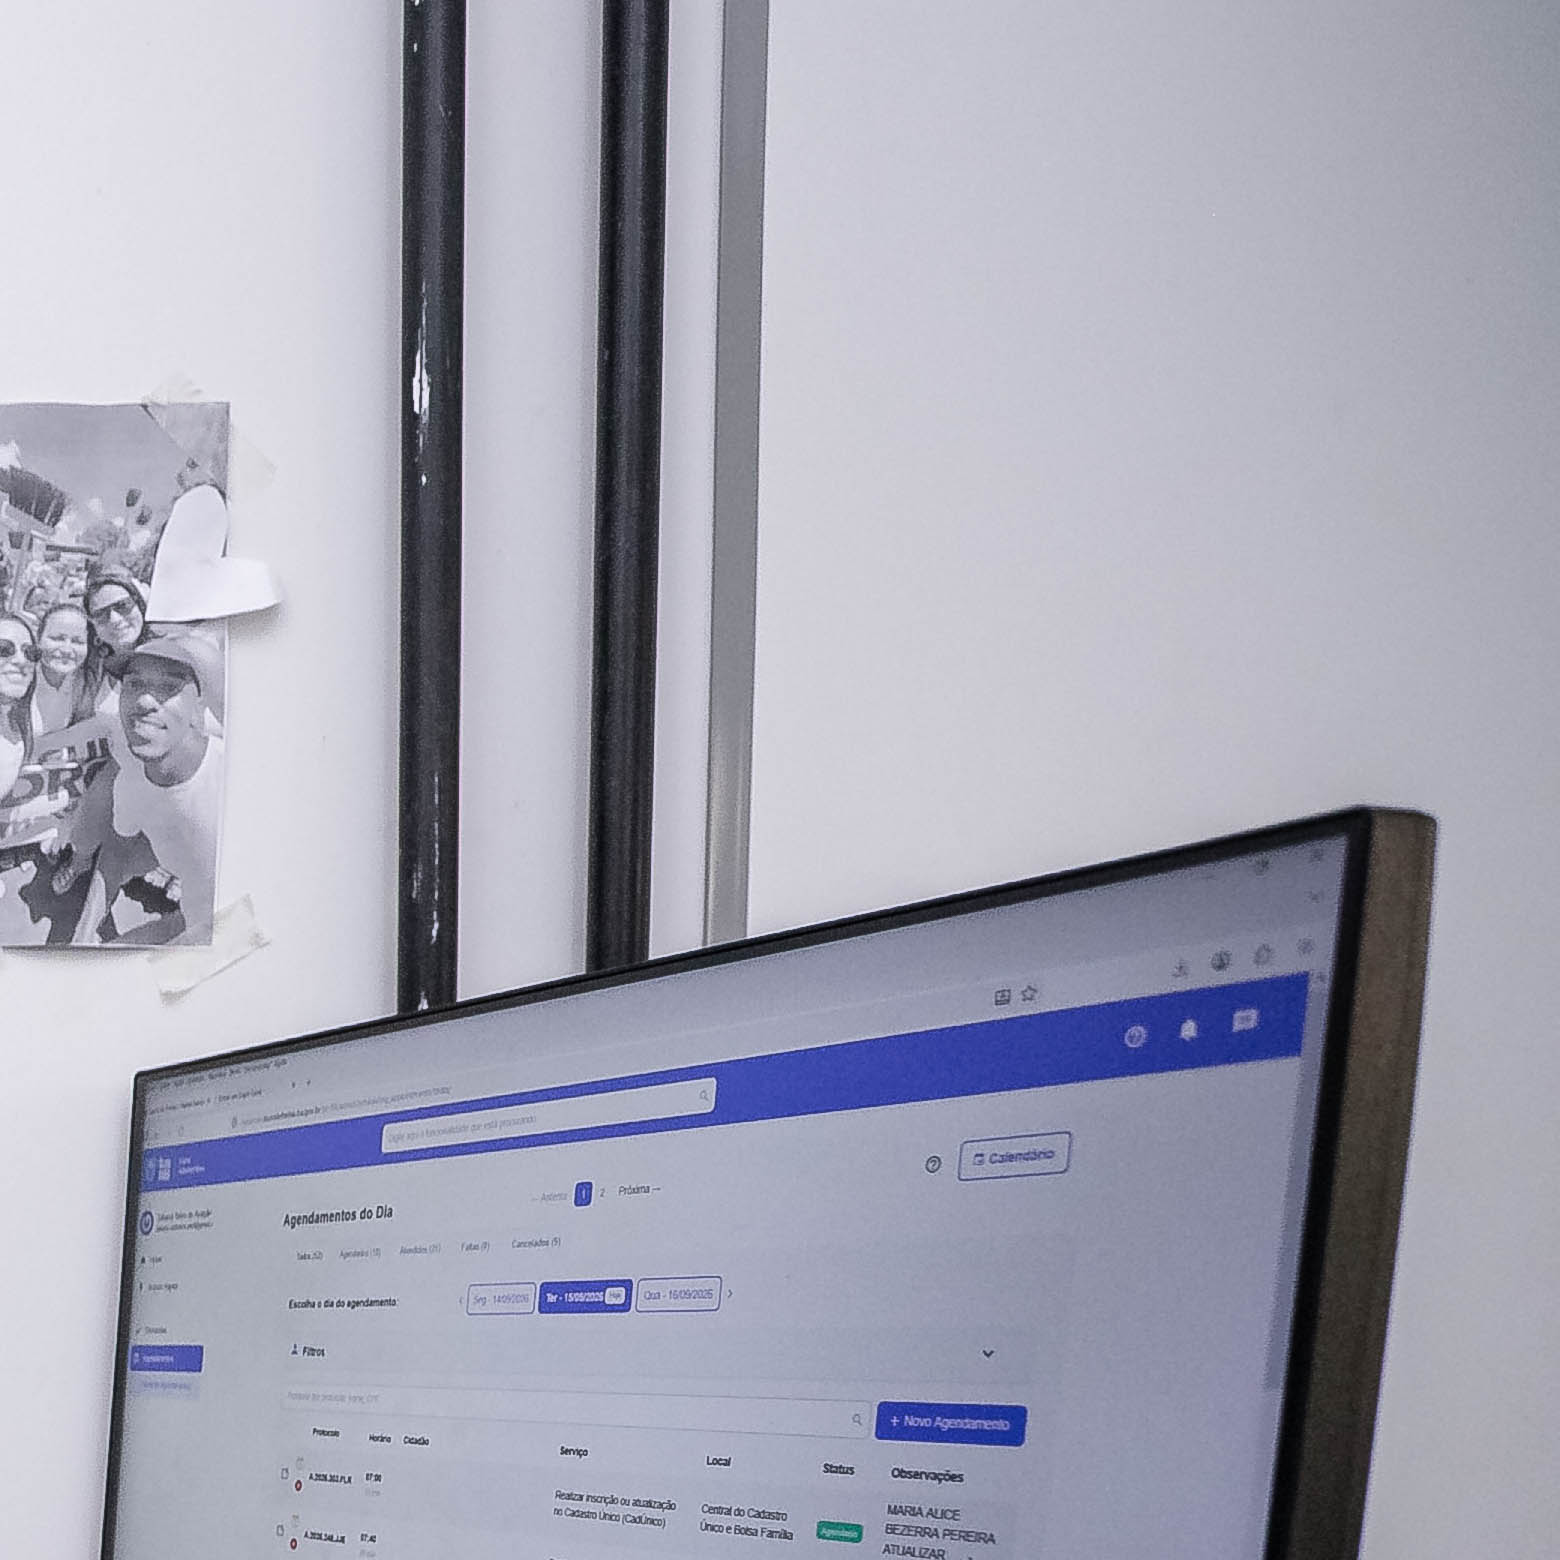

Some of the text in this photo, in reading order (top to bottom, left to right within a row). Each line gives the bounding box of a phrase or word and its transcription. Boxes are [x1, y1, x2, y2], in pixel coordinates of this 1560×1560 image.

[600, 1188, 605, 1197] 2
[618, 1183, 650, 1196] Próxima
[283, 1205, 393, 1229] Agendamentos do Dia
[512, 1238, 550, 1249] Cancelados
[644, 1289, 660, 1300] Qua
[289, 1298, 316, 1309] Escolha
[323, 1298, 336, 1308] dia
[336, 1298, 345, 1308] do
[303, 1346, 325, 1357] Filtros
[904, 1416, 1010, 1431] Novo Agendamento
[560, 1446, 589, 1458] Serviço
[706, 1456, 731, 1467] Local
[823, 1463, 855, 1476] Status
[891, 1468, 964, 1484] Observações
[564, 1508, 597, 1519] Cadastro
[702, 1504, 787, 1520] Central do Cadastro
[888, 1504, 960, 1521] MARIA ALICE
[700, 1521, 724, 1533] Único
[734, 1525, 758, 1536] Bolsa
[761, 1528, 793, 1540] Família
[885, 1524, 996, 1544] BEZERRA PEREIRA
[882, 1544, 945, 1560] ATUALIZAR
